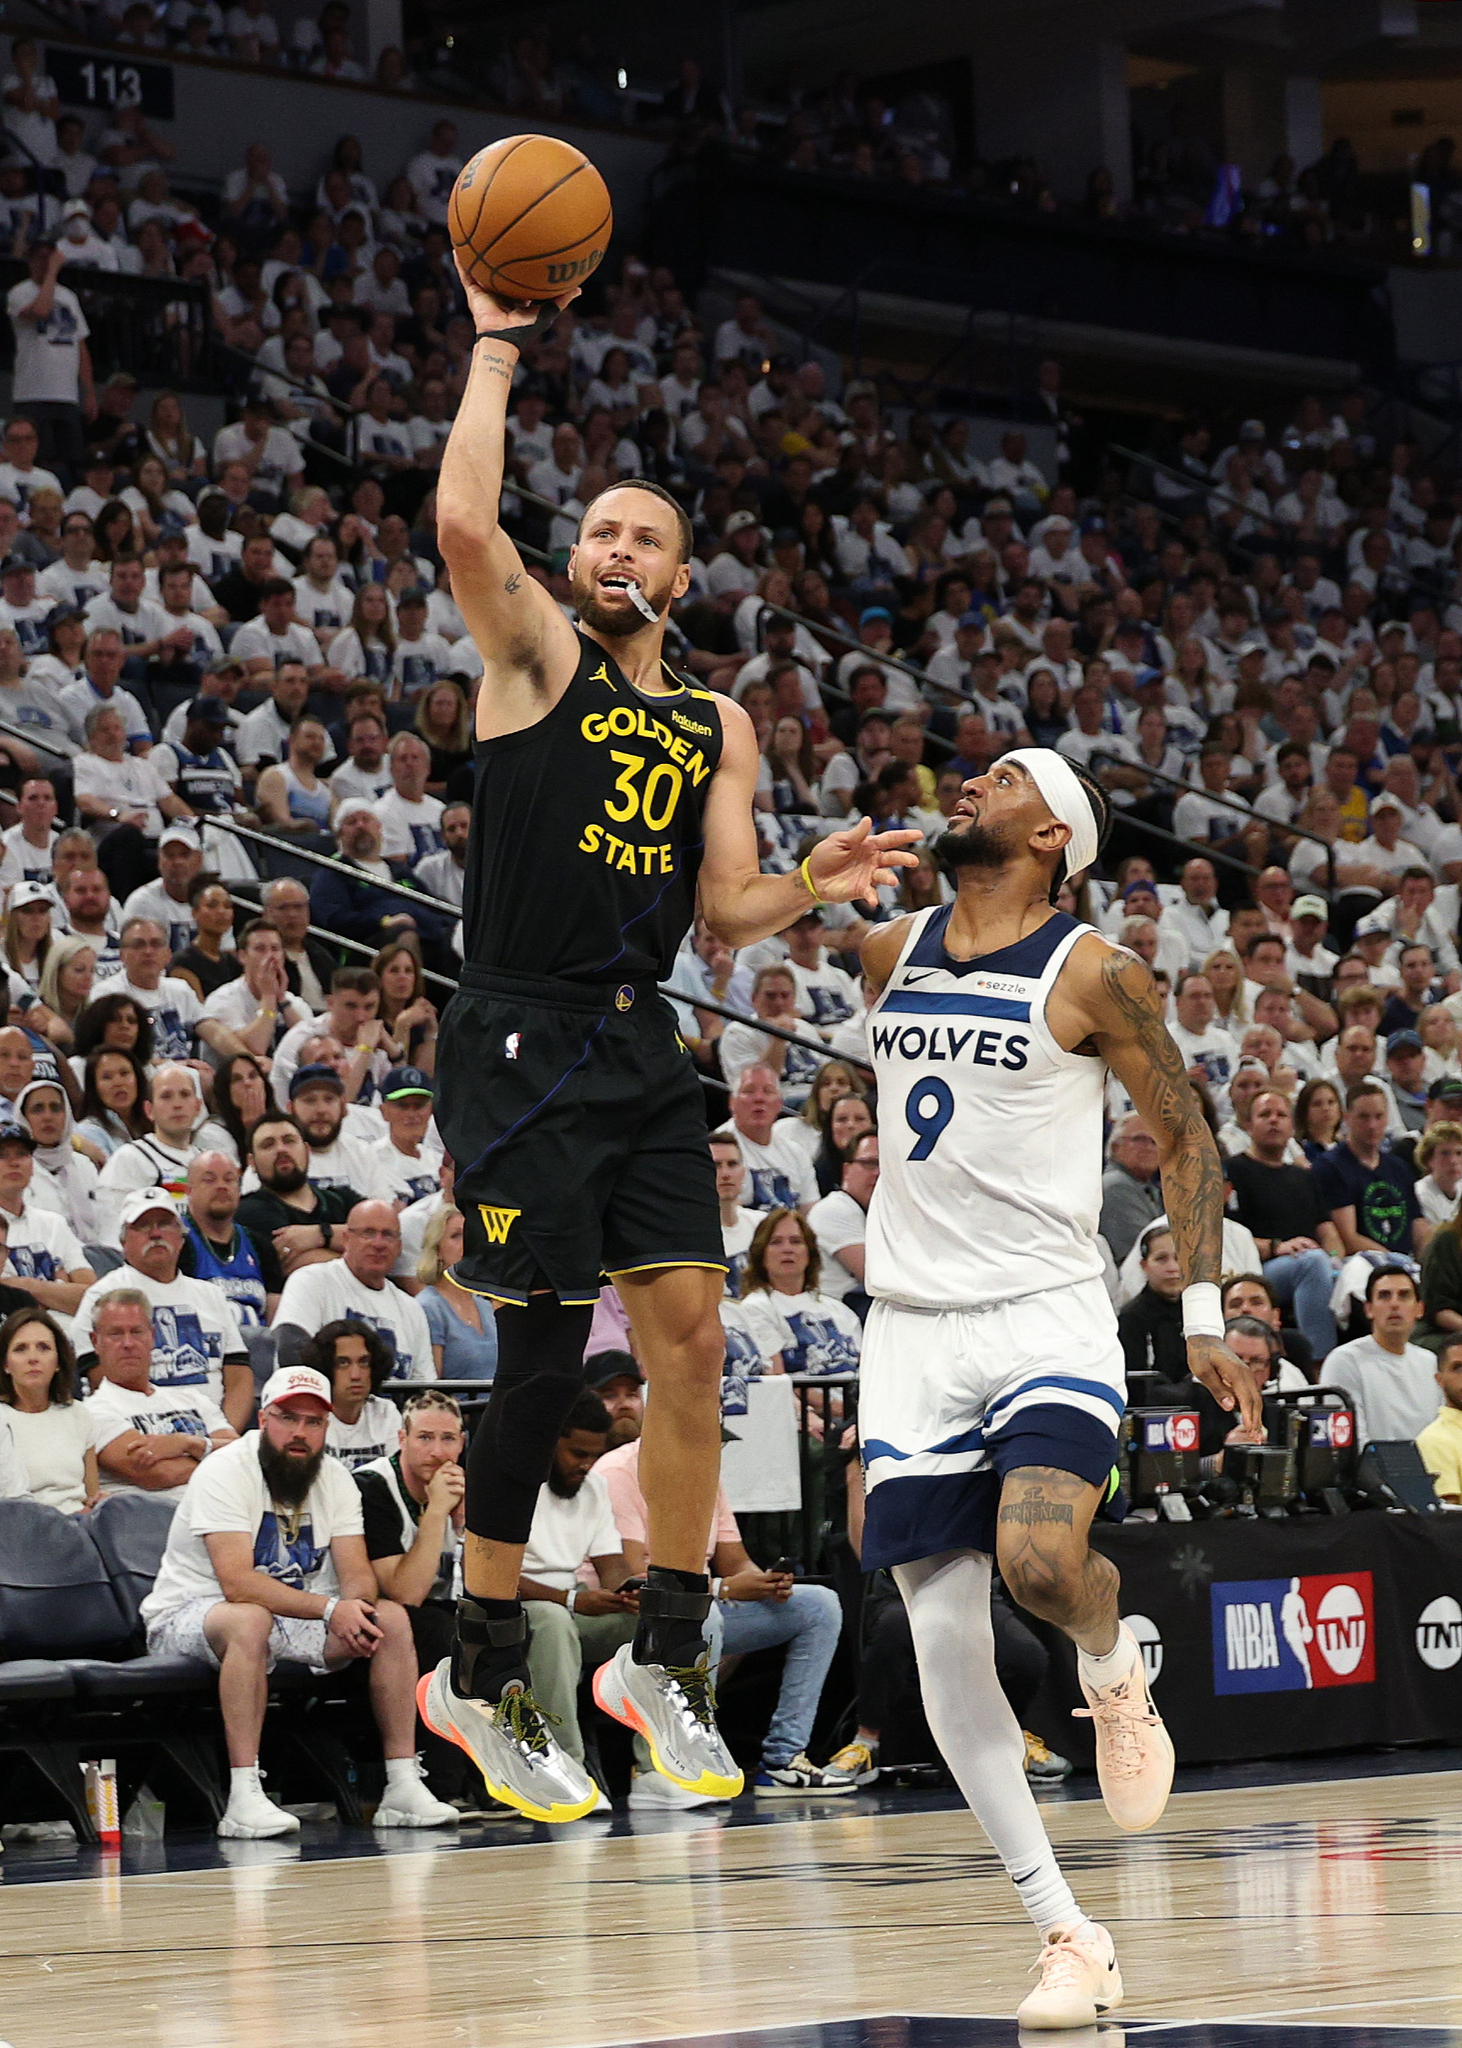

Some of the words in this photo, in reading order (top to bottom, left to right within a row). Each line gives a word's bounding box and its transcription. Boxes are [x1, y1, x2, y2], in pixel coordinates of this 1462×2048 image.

[80, 61, 142, 104] 113
[581, 707, 710, 787] GOLDEN
[671, 709, 712, 737] Rakuten
[604, 750, 683, 831] 30
[578, 823, 674, 875] STATE
[985, 980, 1026, 995] sezzle
[872, 1026, 1030, 1070] WOLVES
[905, 1075, 955, 1161] 9
[1224, 1602, 1280, 1670] NBA
[1316, 1616, 1366, 1651] TNT
